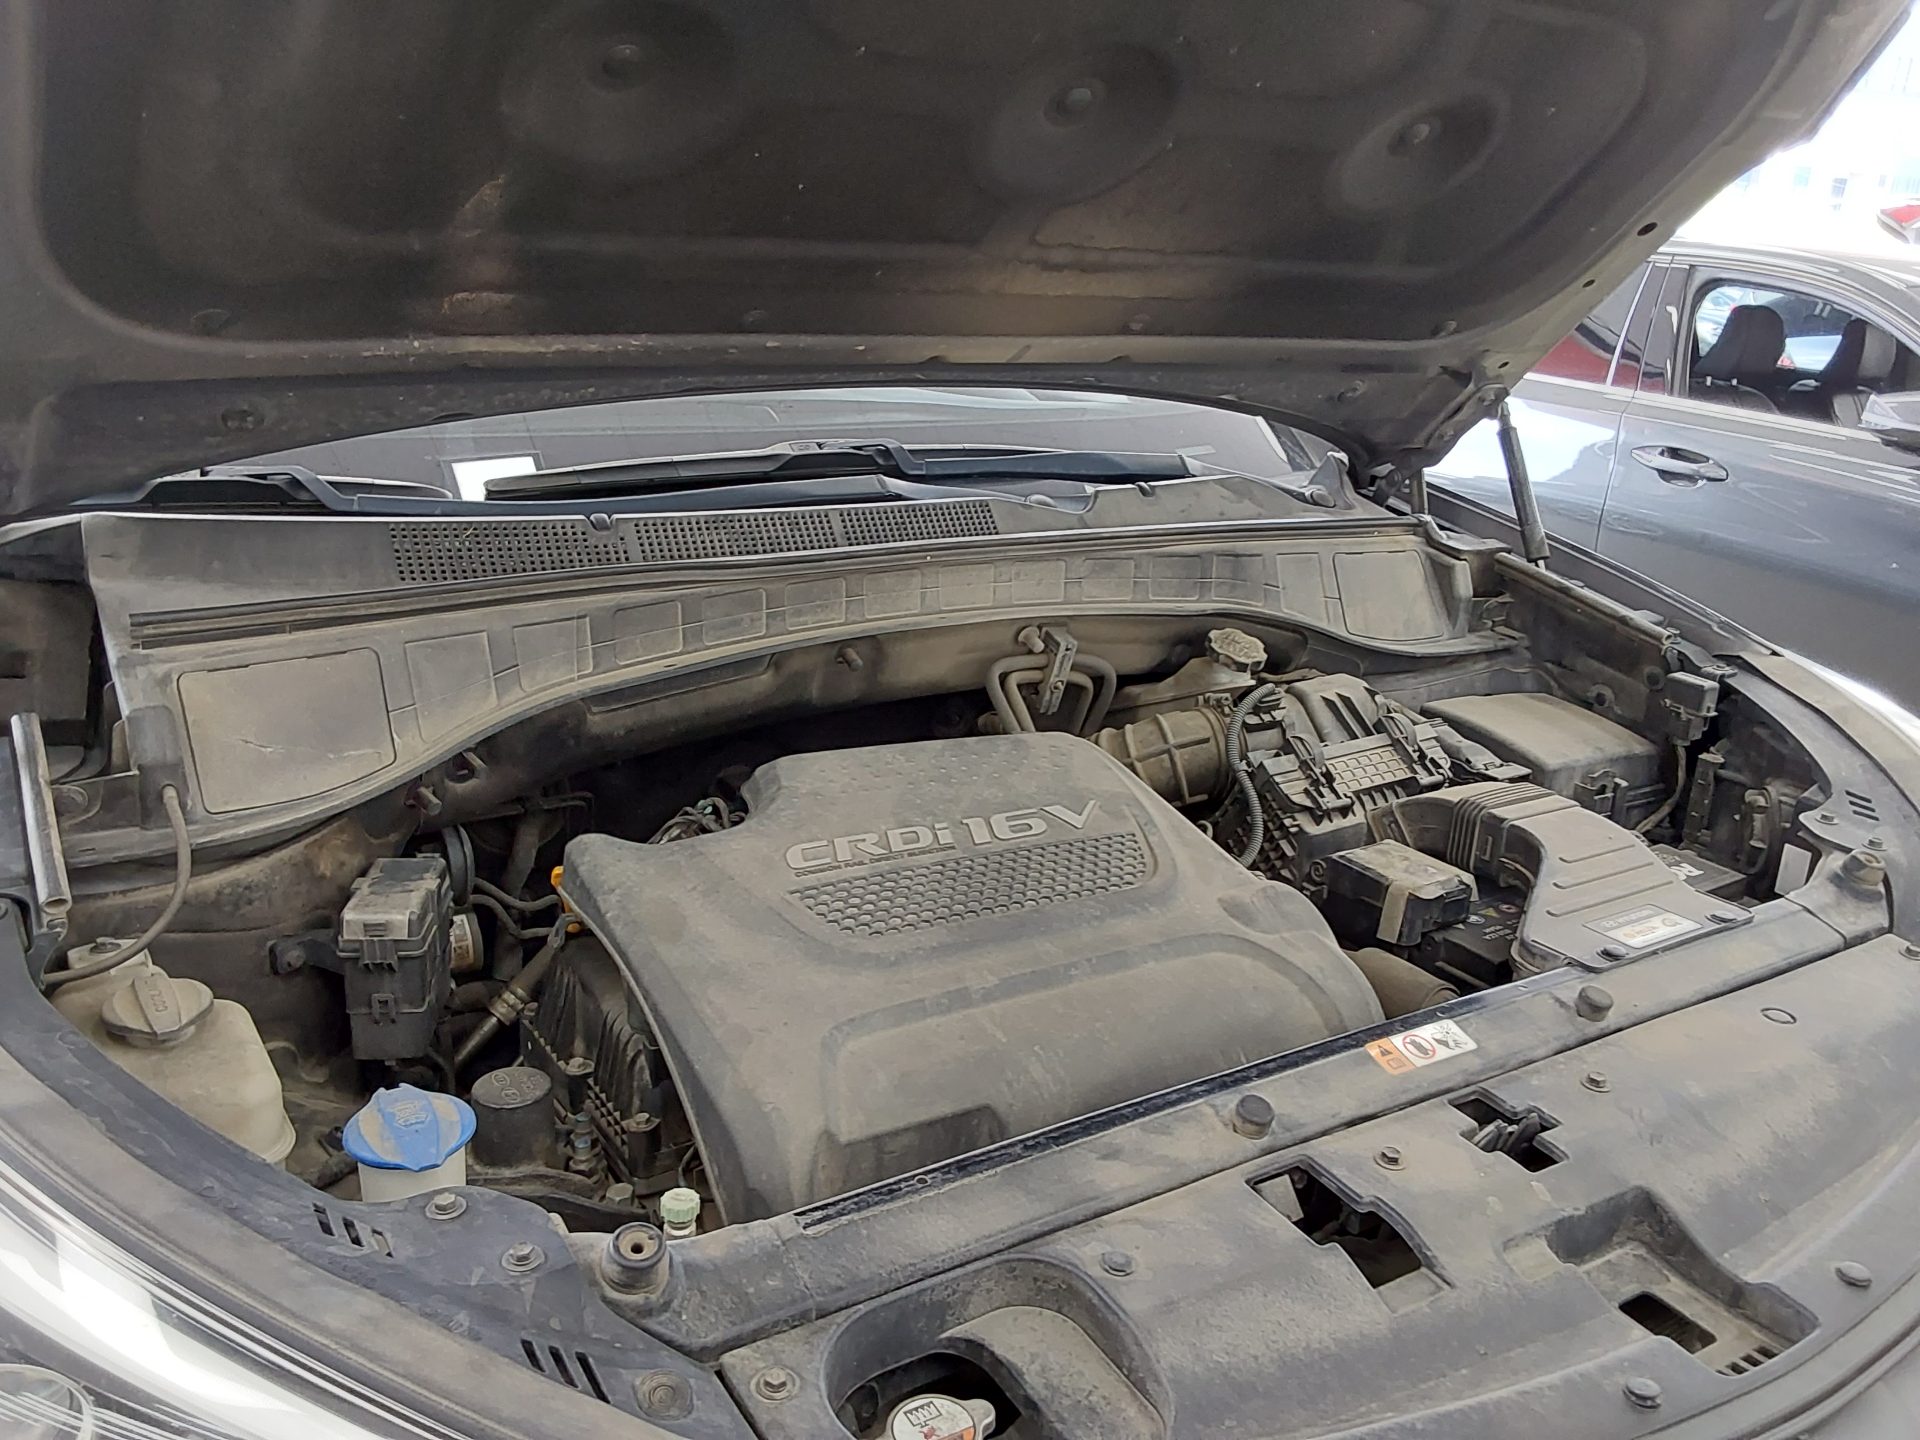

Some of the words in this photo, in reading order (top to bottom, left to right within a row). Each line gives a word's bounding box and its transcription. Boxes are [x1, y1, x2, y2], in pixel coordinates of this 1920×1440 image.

[785, 822, 955, 870] CRDi
[961, 800, 1097, 846] 16V
[795, 864, 843, 878] COMMON
[844, 859, 868, 870] RAIL
[869, 853, 905, 865] DIRECT
